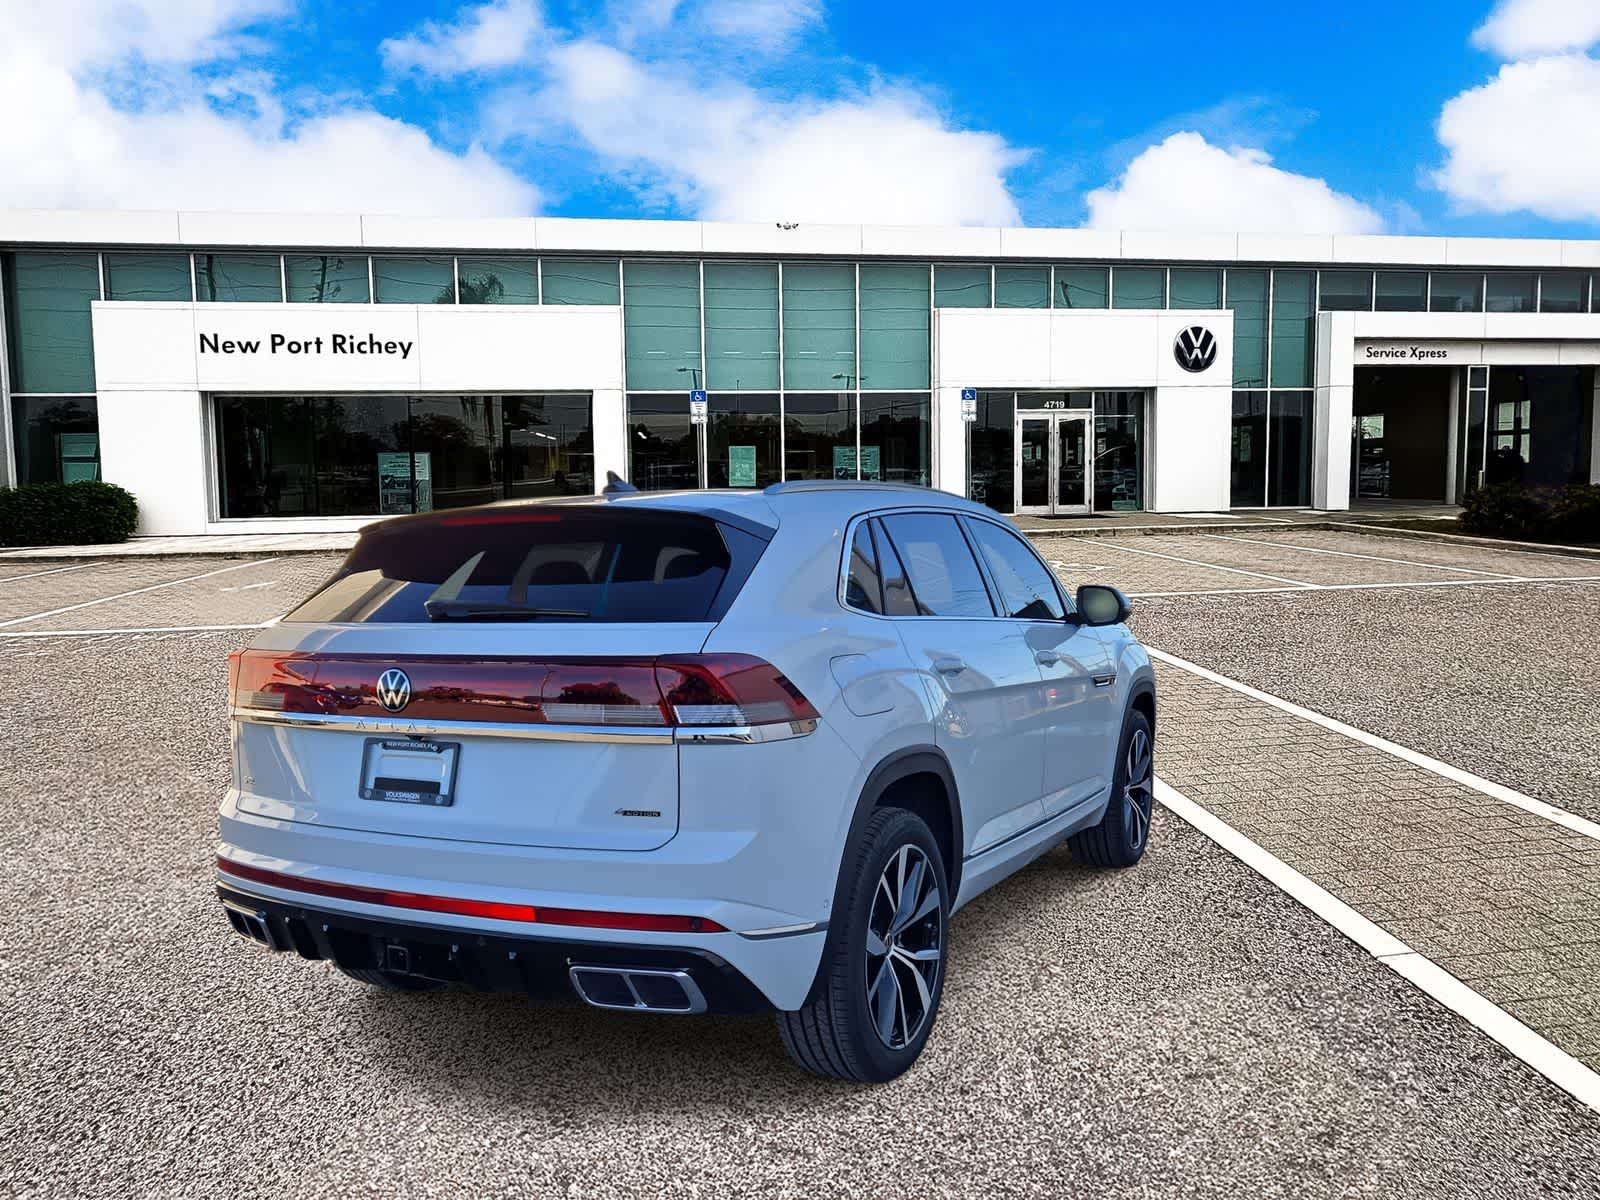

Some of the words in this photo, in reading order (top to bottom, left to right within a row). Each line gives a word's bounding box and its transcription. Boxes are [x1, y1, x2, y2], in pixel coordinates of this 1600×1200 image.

[199, 333, 261, 354] New
[270, 334, 323, 354] Port
[332, 333, 413, 359] Richey
[1174, 326, 1217, 372] VW
[1366, 346, 1407, 358] Service
[1409, 347, 1447, 361] Xpress
[1044, 400, 1065, 409] 4719
[377, 668, 411, 713] VW
[385, 791, 421, 800] VOLKSWAGEN
